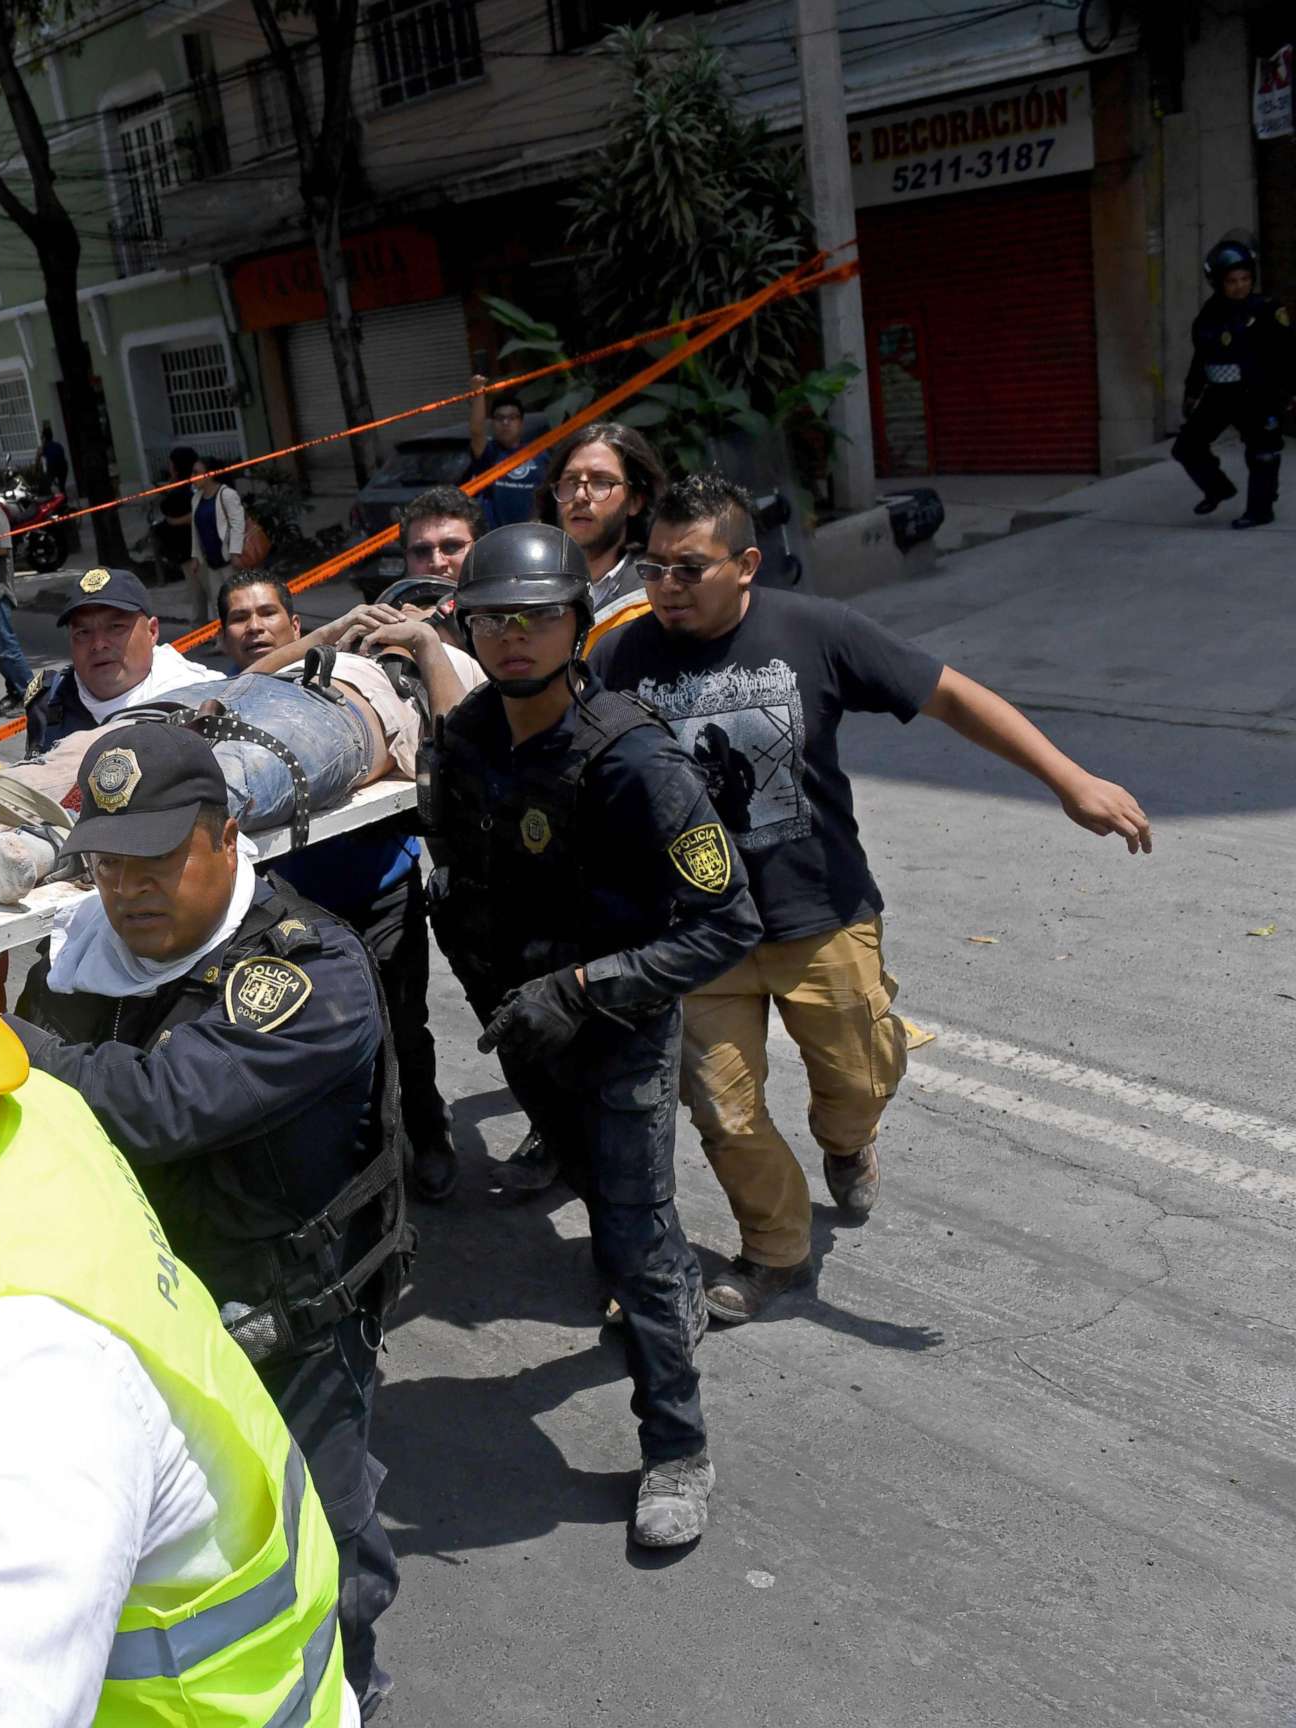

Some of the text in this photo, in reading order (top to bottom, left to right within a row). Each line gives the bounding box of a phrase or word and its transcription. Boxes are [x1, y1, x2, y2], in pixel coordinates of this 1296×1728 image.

[871, 85, 1068, 161] DECORACIÓN
[892, 139, 1055, 192] 5211-3187
[673, 828, 717, 855] POLICIA
[244, 965, 300, 993] POLICIA
